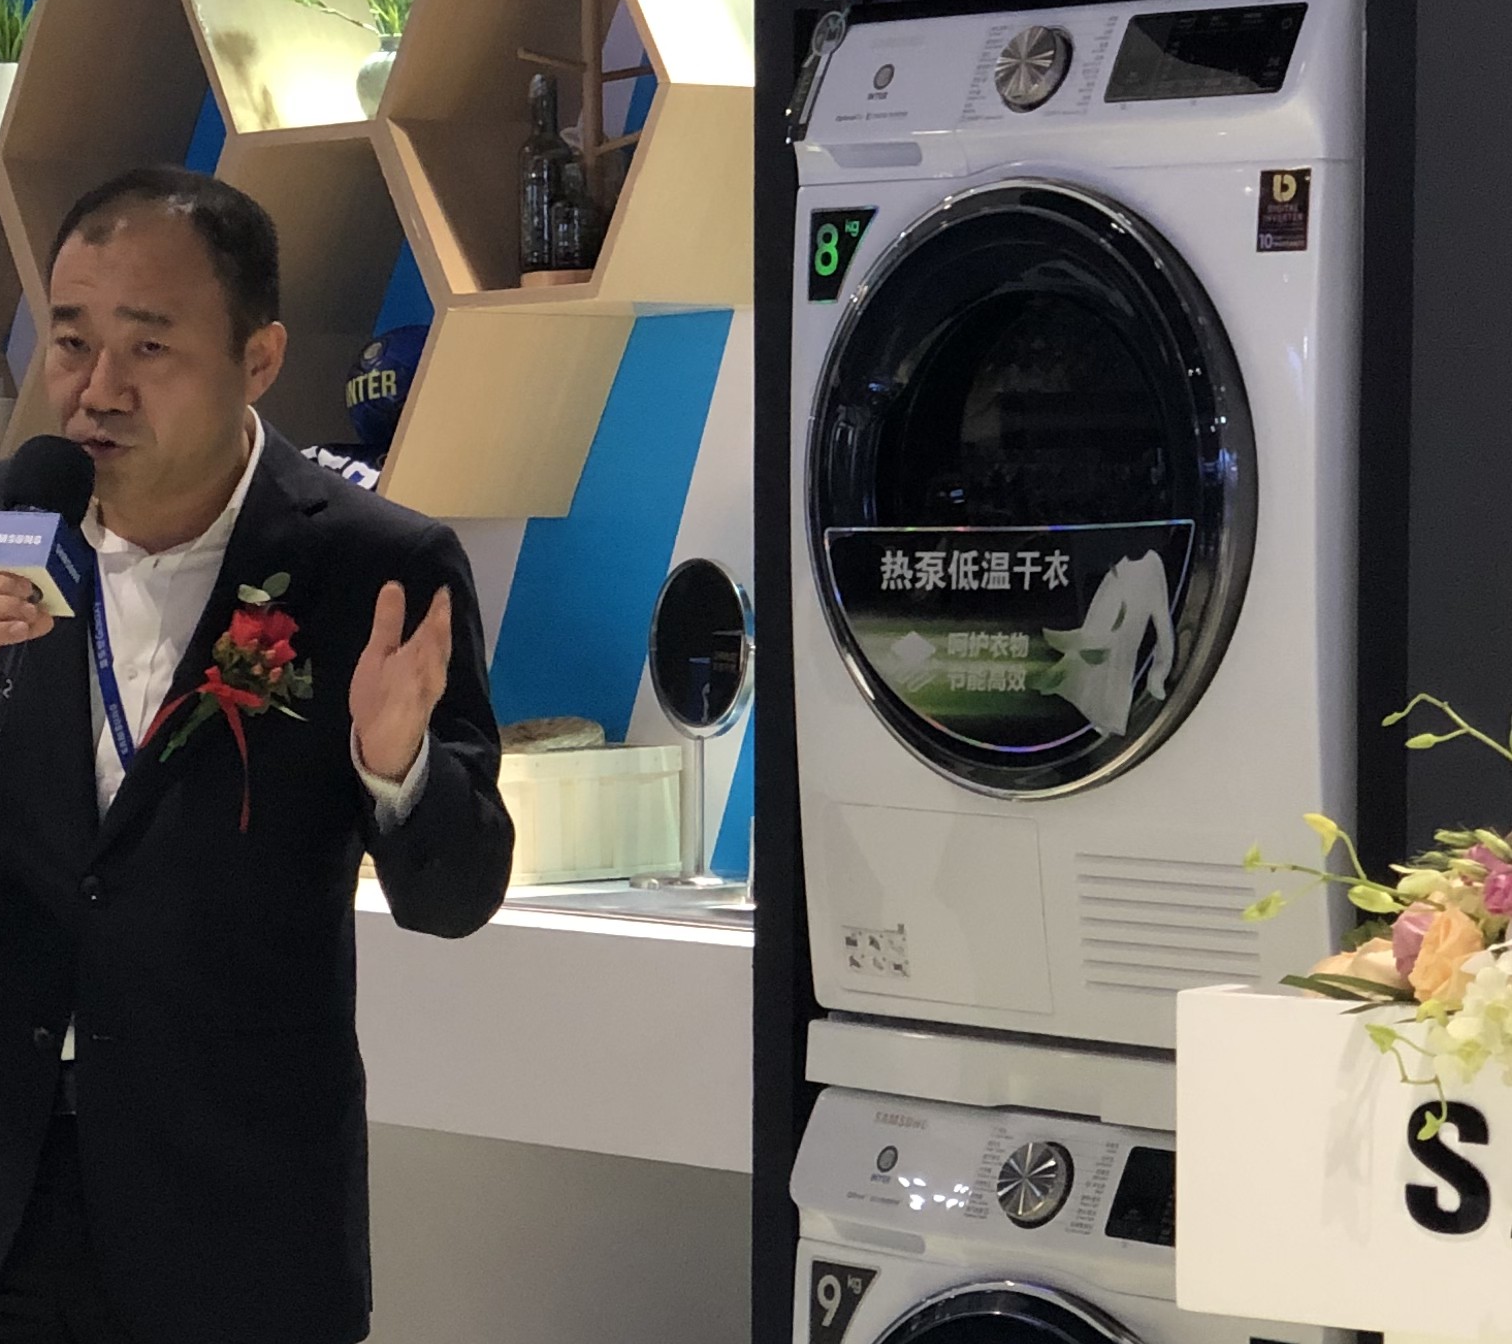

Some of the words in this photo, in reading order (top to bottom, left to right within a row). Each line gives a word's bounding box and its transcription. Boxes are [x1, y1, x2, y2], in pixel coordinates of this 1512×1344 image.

[880, 549, 1070, 591] 热泵低温干衣
[947, 631, 1030, 658] 呵护衣物
[947, 664, 1027, 692] 节能高效
